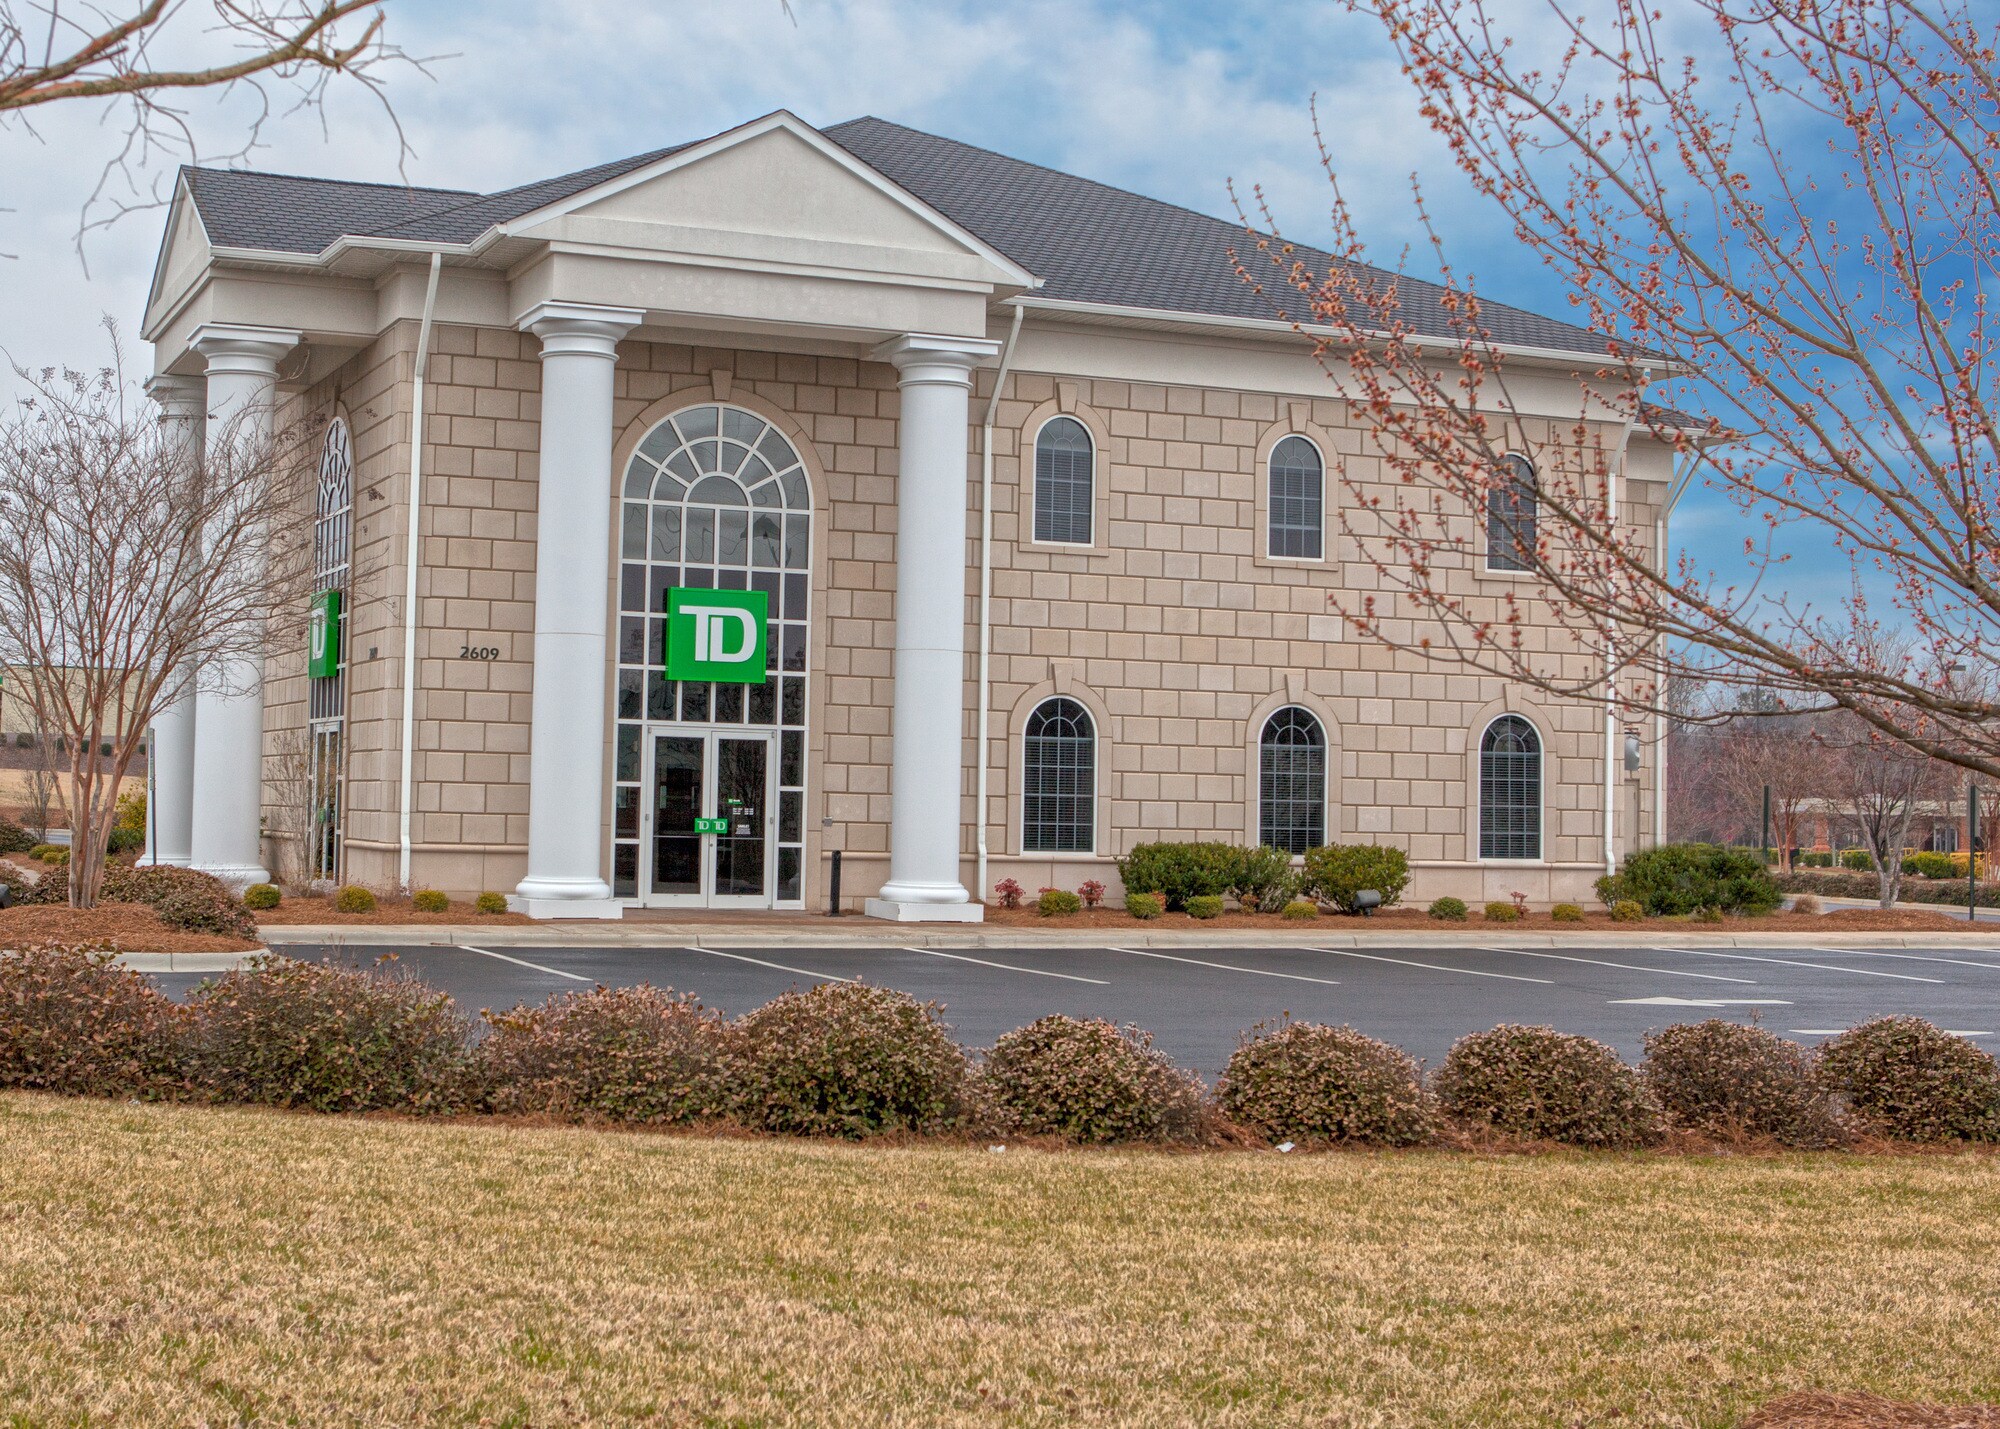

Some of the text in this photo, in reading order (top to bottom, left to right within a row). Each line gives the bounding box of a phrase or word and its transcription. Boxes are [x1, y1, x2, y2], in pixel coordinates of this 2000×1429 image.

[679, 605, 757, 663] TD
[460, 646, 499, 660] 2609
[697, 821, 709, 830] TD
[713, 821, 726, 831] TD
